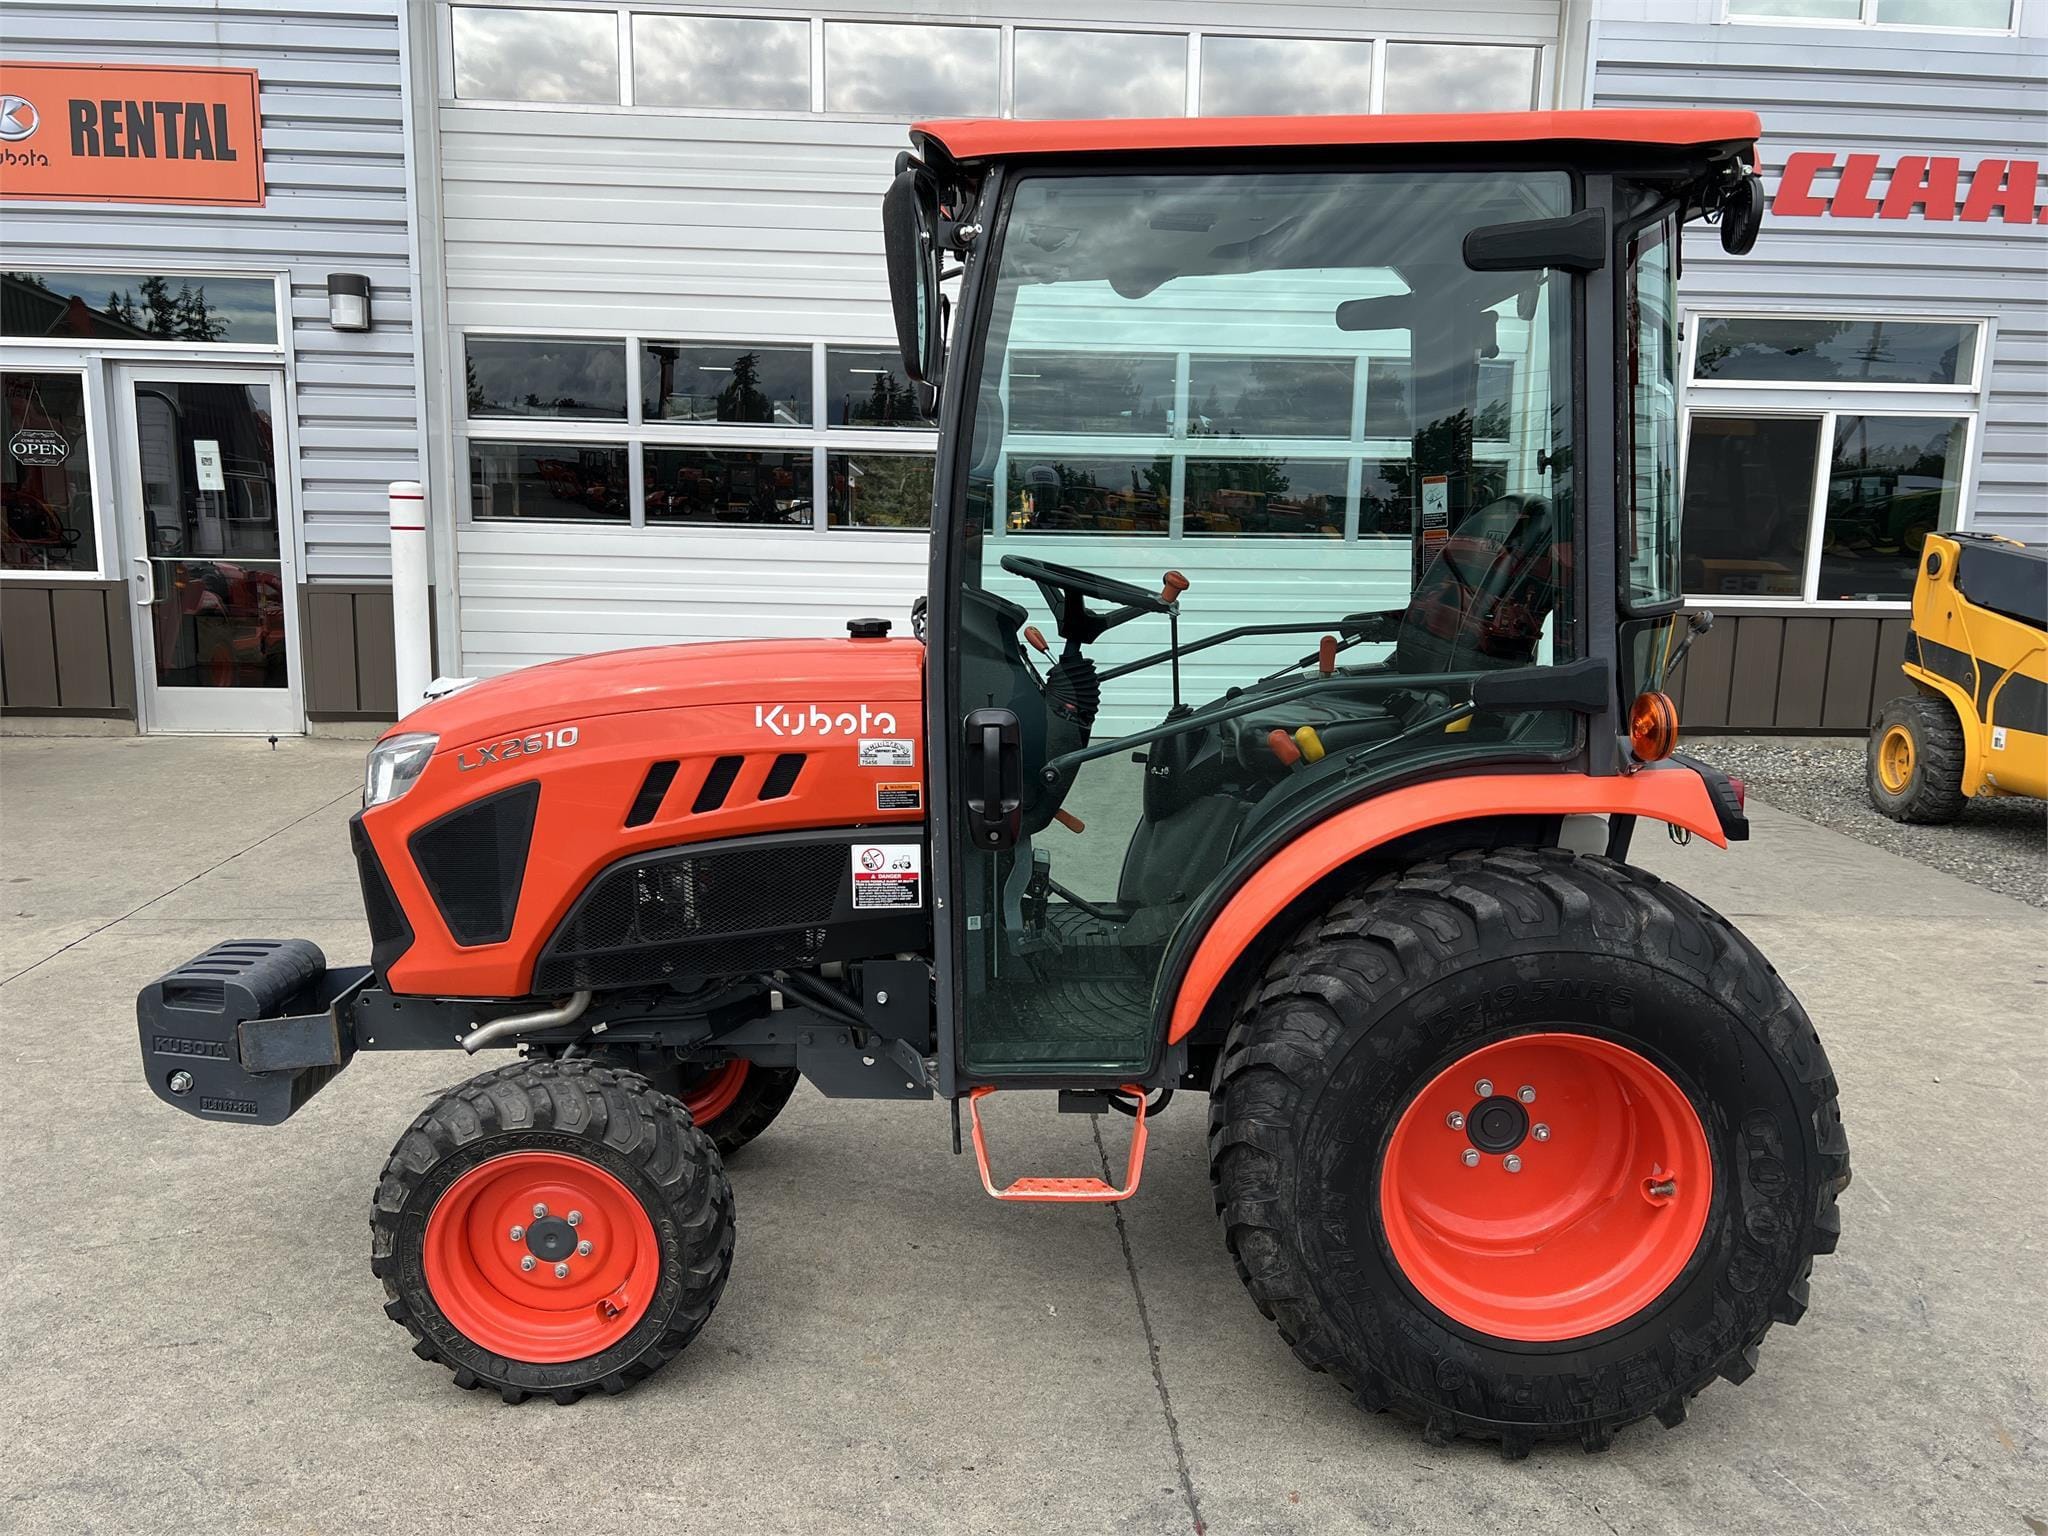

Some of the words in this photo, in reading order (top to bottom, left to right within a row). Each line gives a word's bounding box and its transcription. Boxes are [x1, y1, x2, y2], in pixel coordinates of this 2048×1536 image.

[68, 99, 237, 161] RENTAL
[1771, 151, 2048, 225] CLAA
[12, 443, 65, 456] OPEN
[755, 704, 897, 736] Kubota
[457, 726, 579, 772] LX2610
[155, 1037, 227, 1057] KUBOTA
